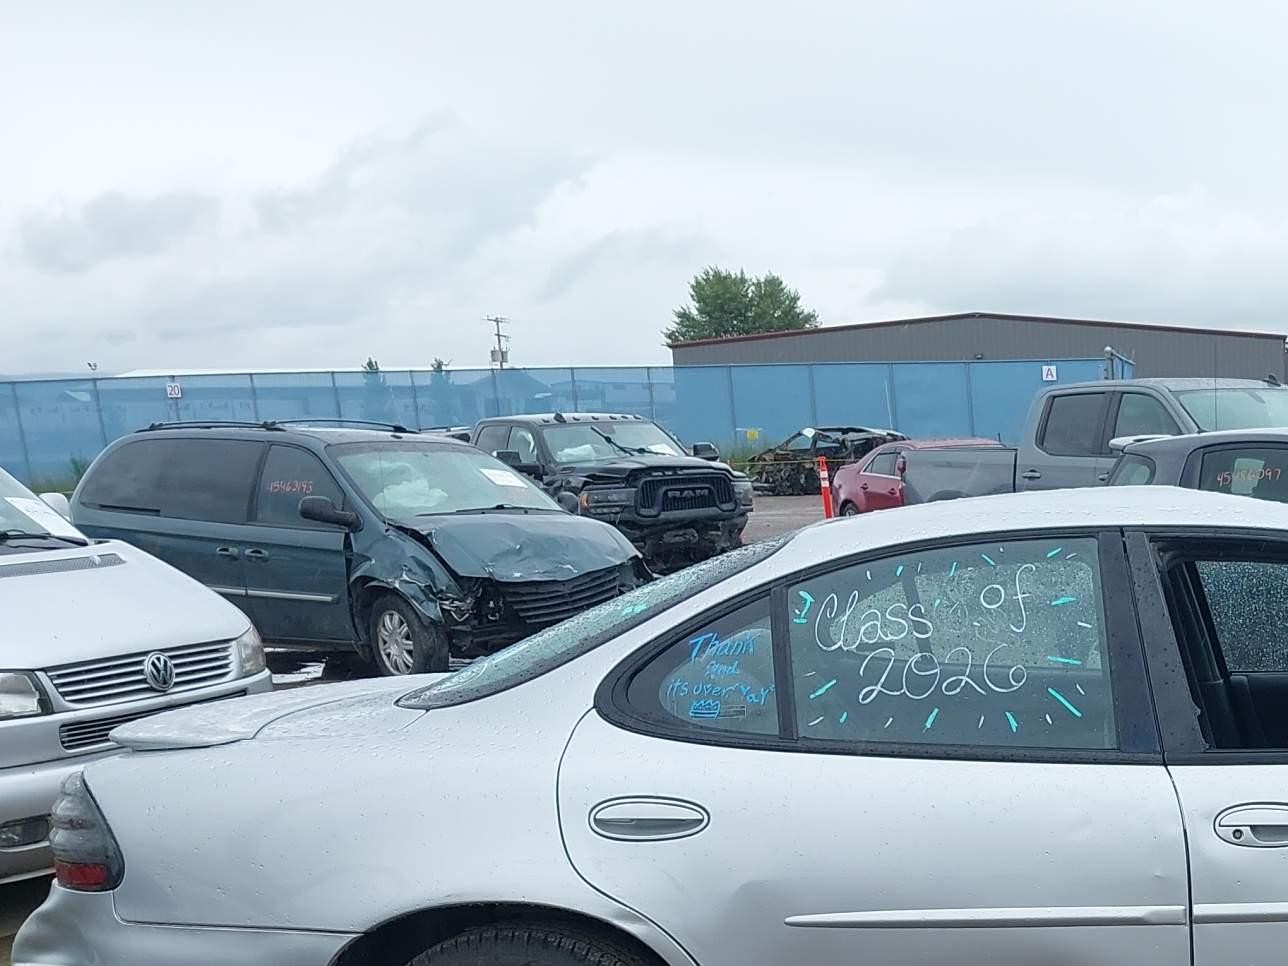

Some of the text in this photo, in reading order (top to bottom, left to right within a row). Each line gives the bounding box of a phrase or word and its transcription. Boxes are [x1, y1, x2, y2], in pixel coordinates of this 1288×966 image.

[1045, 367, 1055, 379] A
[167, 384, 180, 396] 20
[667, 489, 709, 498] RAM
[815, 564, 1036, 650] Class of
[688, 631, 760, 662] Thank
[859, 643, 1027, 704] 2026
